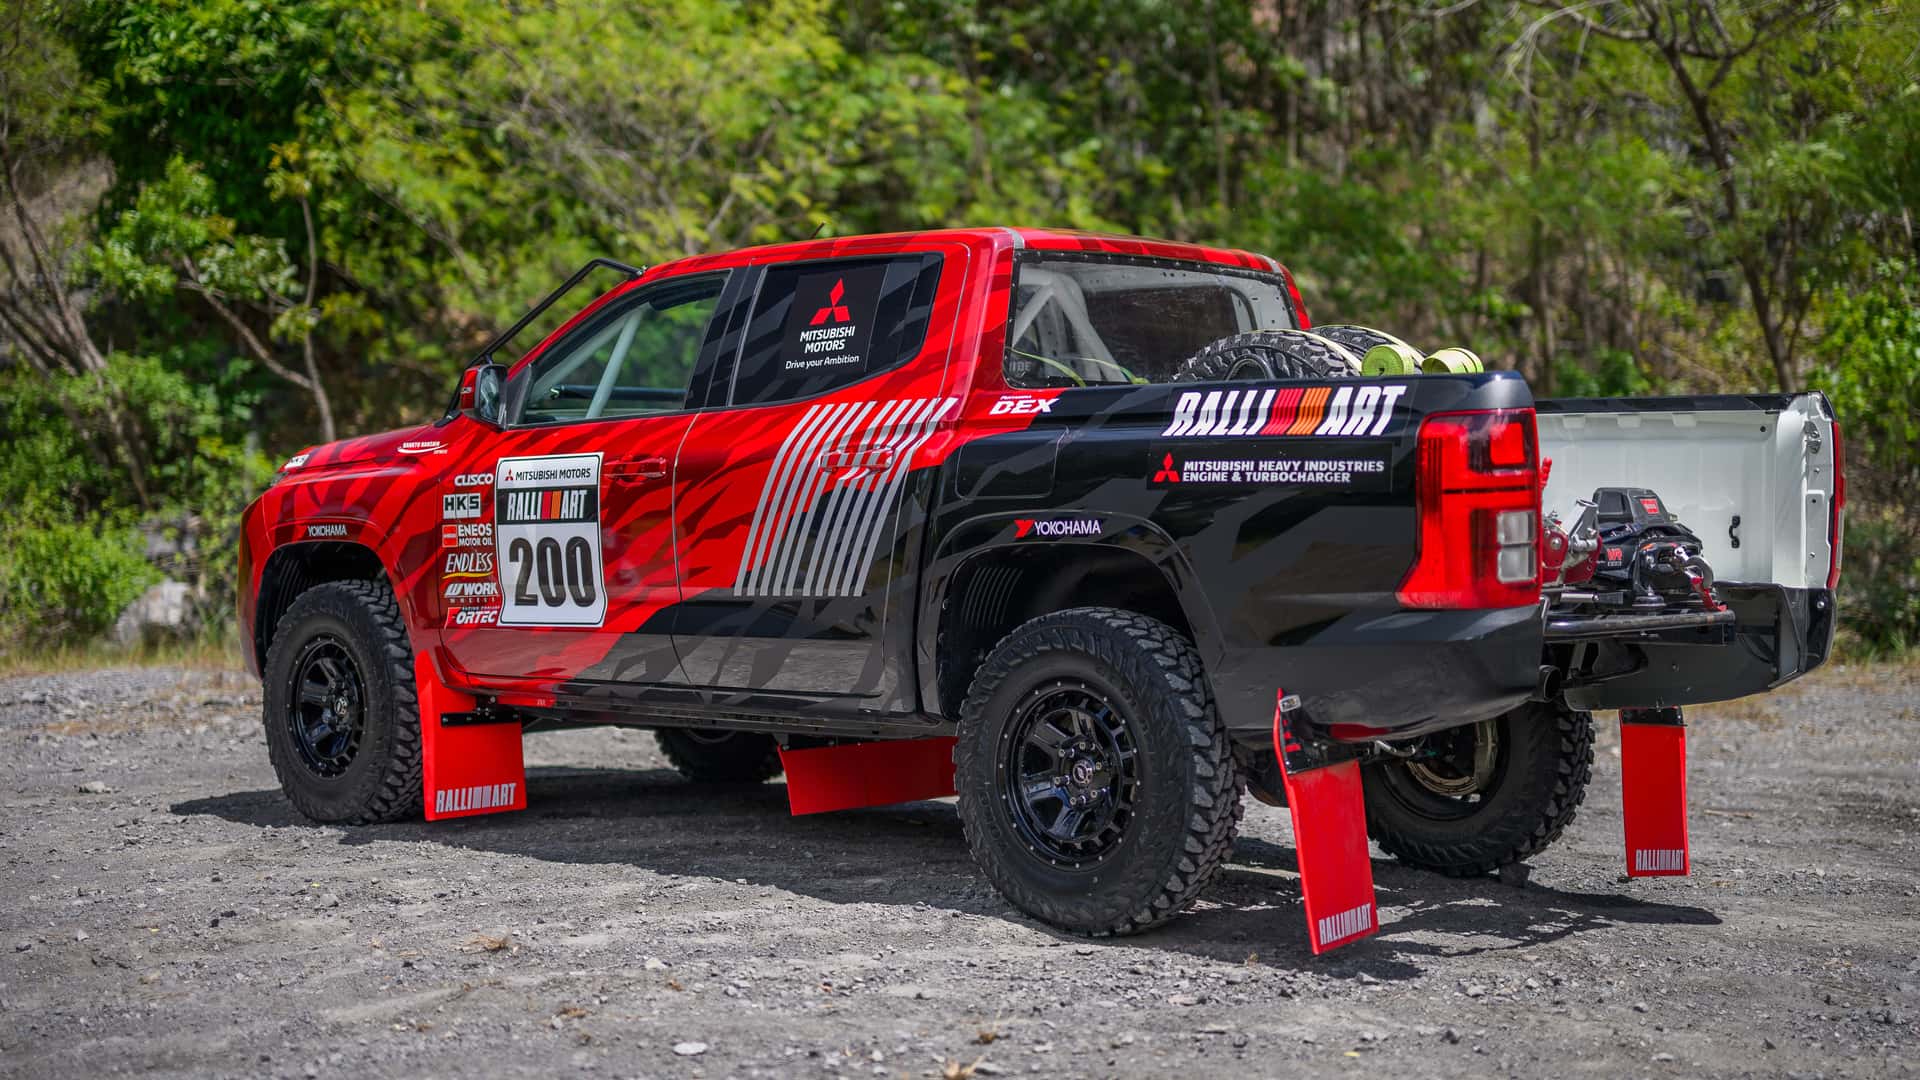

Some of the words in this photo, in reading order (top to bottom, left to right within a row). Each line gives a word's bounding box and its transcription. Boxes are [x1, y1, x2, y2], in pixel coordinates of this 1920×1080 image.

[800, 326, 856, 342] MITSUBISHI
[804, 339, 846, 354] MOTORS
[785, 360, 806, 370] Drive
[806, 359, 824, 370] your
[824, 355, 860, 366] Ambition
[989, 398, 1060, 415] DEX
[1184, 461, 1256, 472] MITSUBISHI
[1259, 461, 1301, 472] HEAVY
[1304, 461, 1386, 472] INDUSTRIES
[454, 473, 494, 486] CUSCO
[515, 468, 558, 481] MITSUBISHI
[559, 467, 591, 480] MOTORS
[1183, 472, 1229, 482] ENGINE
[1231, 472, 1241, 482] &
[1245, 472, 1352, 482] TURBOCHARGER
[444, 496, 480, 512] HKS
[307, 524, 347, 537] YOKOHAMA
[458, 523, 492, 536] ENEOS
[1034, 520, 1101, 535] YOKOHAMA
[458, 536, 481, 547] MOTOR
[482, 536, 493, 546] OIL
[445, 553, 493, 573] ENDLESS
[509, 536, 597, 607] 200
[464, 582, 499, 596] WORK
